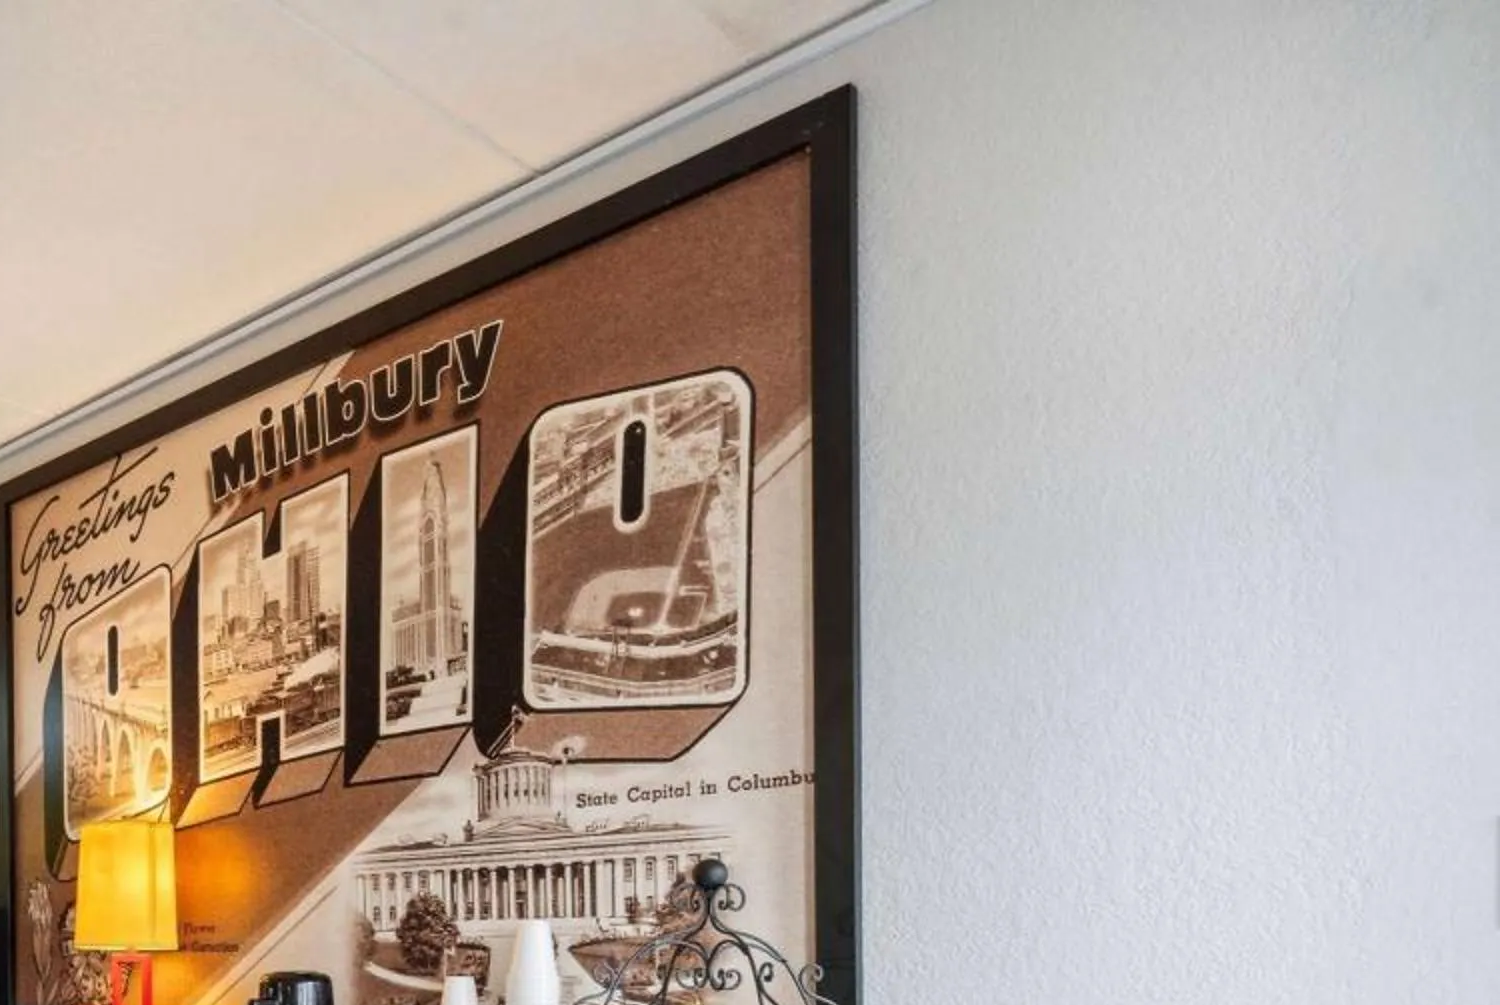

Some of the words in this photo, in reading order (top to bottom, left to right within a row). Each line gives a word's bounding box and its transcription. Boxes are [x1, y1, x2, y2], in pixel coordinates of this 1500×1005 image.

[207, 319, 504, 504] Millbury
[14, 446, 176, 617] Greetings
[36, 557, 141, 664] from
[52, 366, 757, 860] OHIO
[575, 791, 619, 810] State
[699, 778, 718, 796] in
[726, 768, 816, 794] Columbu
